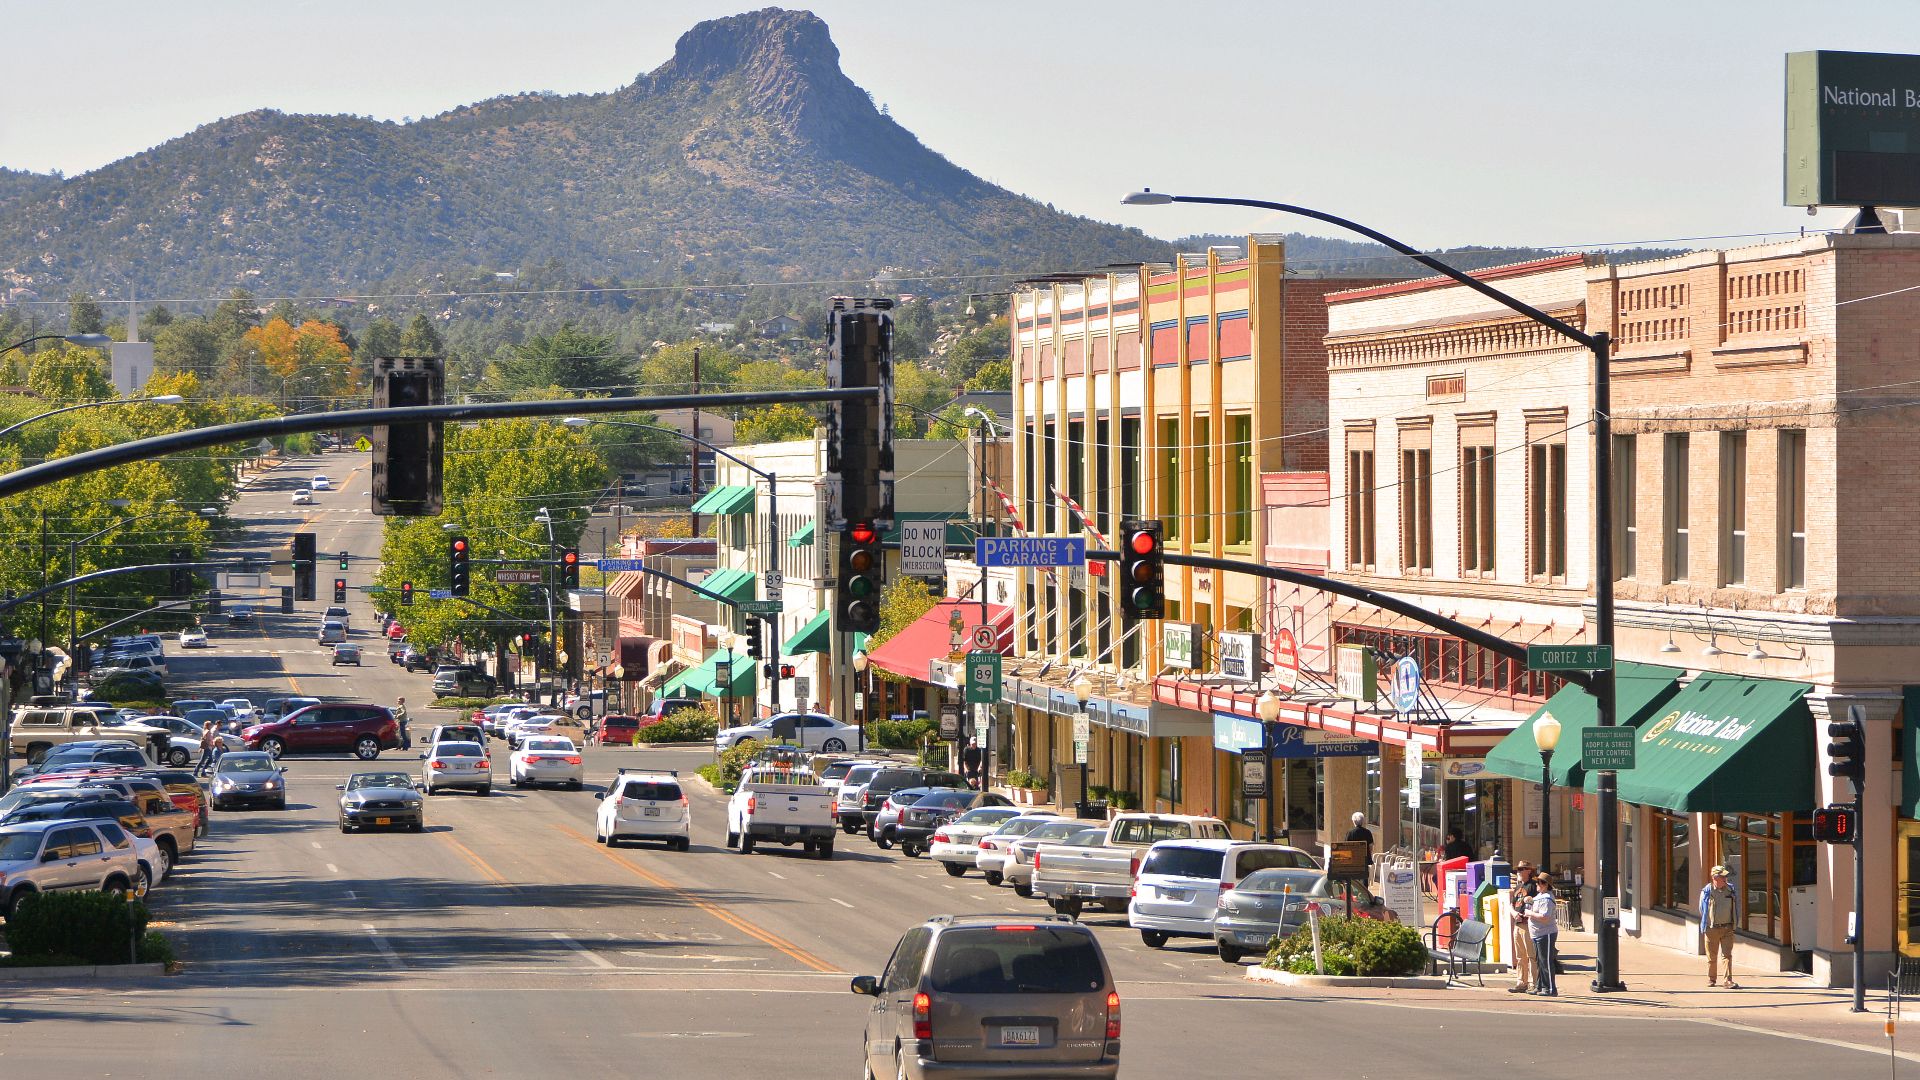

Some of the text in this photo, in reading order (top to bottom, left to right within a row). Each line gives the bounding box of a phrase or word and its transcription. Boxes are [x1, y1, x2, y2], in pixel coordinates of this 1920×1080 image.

[1824, 85, 1896, 107] National
[904, 528, 943, 540] DO NOT
[903, 546, 942, 558] BLOCK
[984, 540, 1057, 565] PARKING
[1002, 552, 1057, 565] GARAGE
[601, 560, 631, 570] PARKING
[902, 561, 943, 571] INTERSECTION
[767, 574, 782, 585] 89
[970, 655, 998, 663] SOUTH
[1542, 651, 1598, 664] CORTEZ ST
[976, 669, 992, 680] 89
[1668, 710, 1756, 741] National Bank
[1313, 743, 1359, 755] Jewelers
[1585, 749, 1632, 757] LITTER CONTROL
[1591, 757, 1606, 765] NEXT
[1611, 757, 1625, 765] MILE
